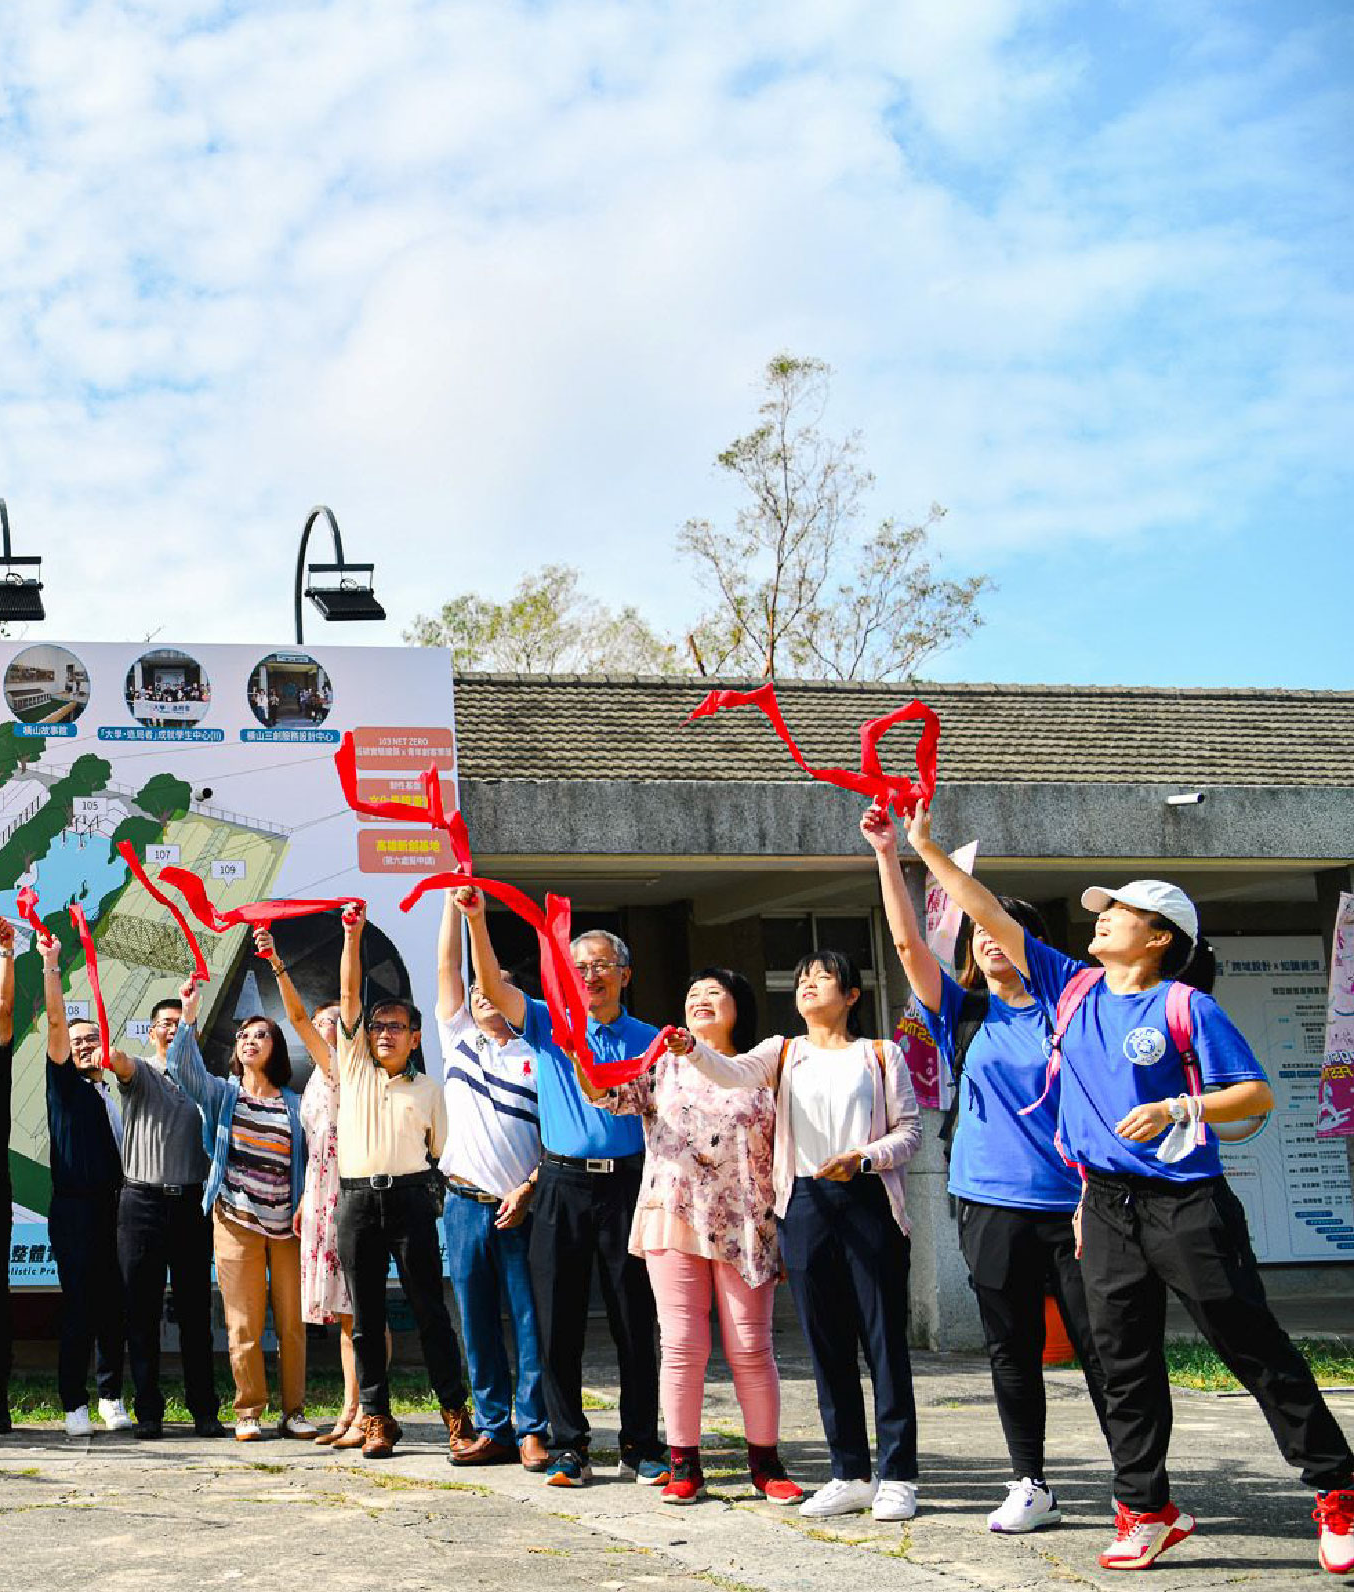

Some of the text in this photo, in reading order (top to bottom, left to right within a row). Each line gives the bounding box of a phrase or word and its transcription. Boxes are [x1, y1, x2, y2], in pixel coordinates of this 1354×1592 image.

[392, 737, 407, 746] NET
[409, 737, 429, 746] ZERO
[82, 801, 99, 811] 105
[155, 850, 171, 860] 107
[220, 865, 236, 875] 109
[9, 1268, 37, 1277] listic
